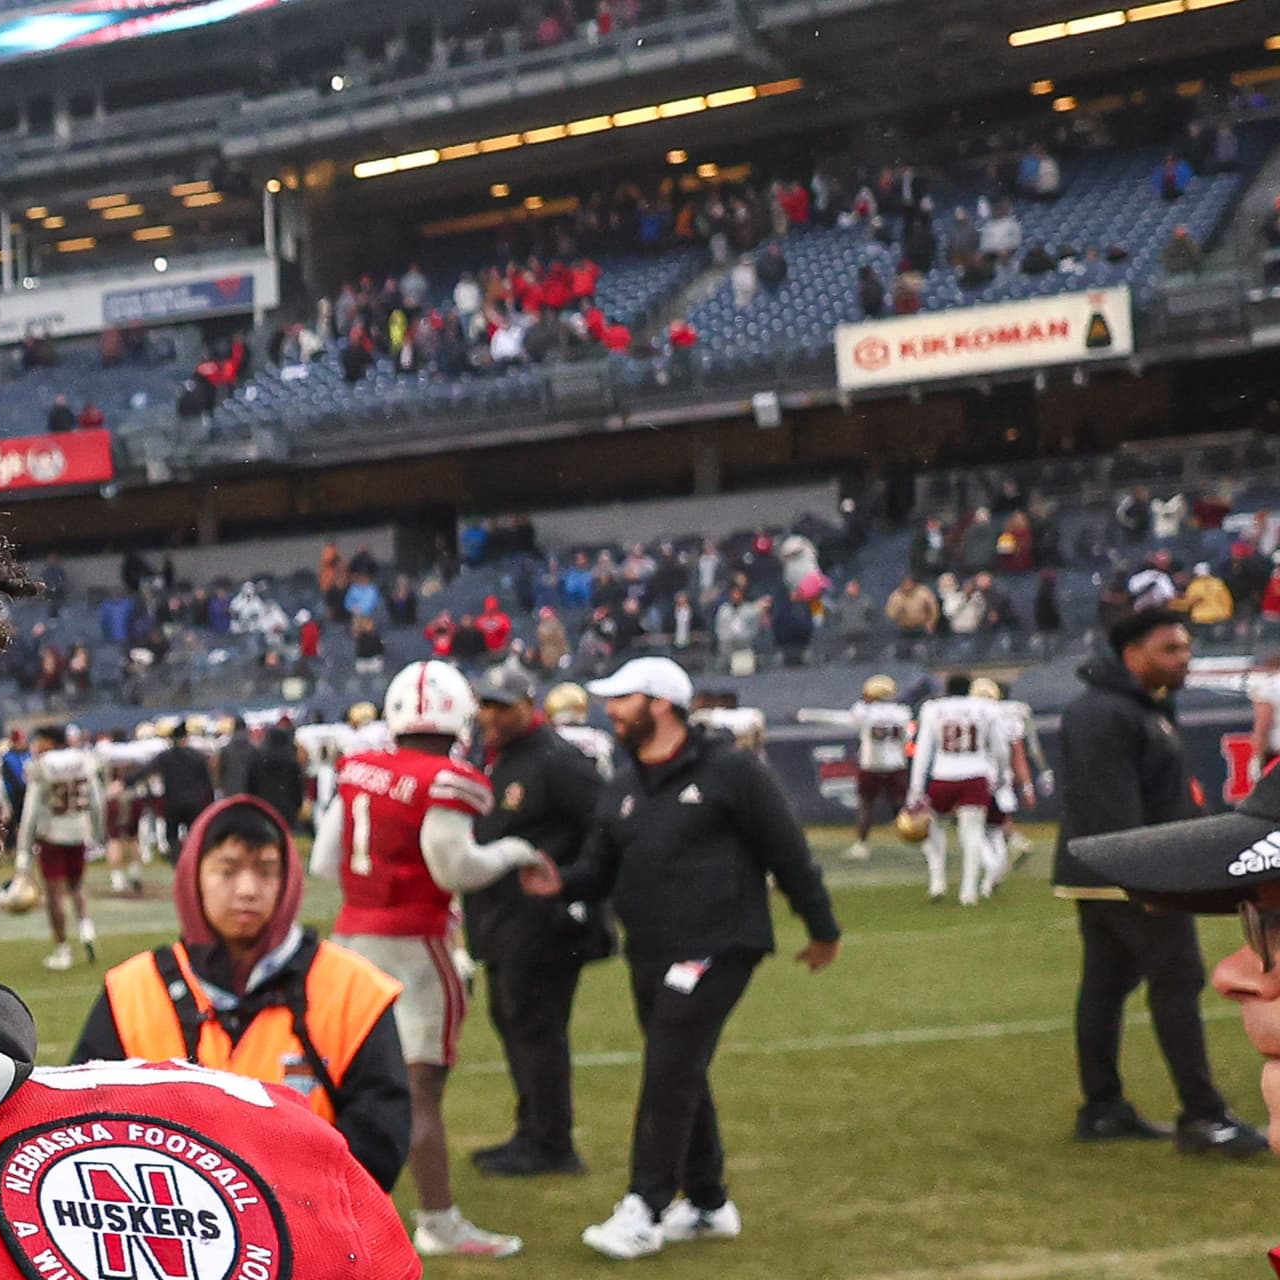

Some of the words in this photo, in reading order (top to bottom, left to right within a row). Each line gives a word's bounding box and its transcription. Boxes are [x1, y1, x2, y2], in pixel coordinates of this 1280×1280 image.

[899, 318, 1070, 359] KIKKOMAN
[349, 791, 373, 877] 1
[5, 1123, 113, 1195] NEBRASKA
[128, 1123, 258, 1213] FOOTBALL
[13, 1220, 39, 1238] A
[52, 1199, 221, 1240] HUSKERS
